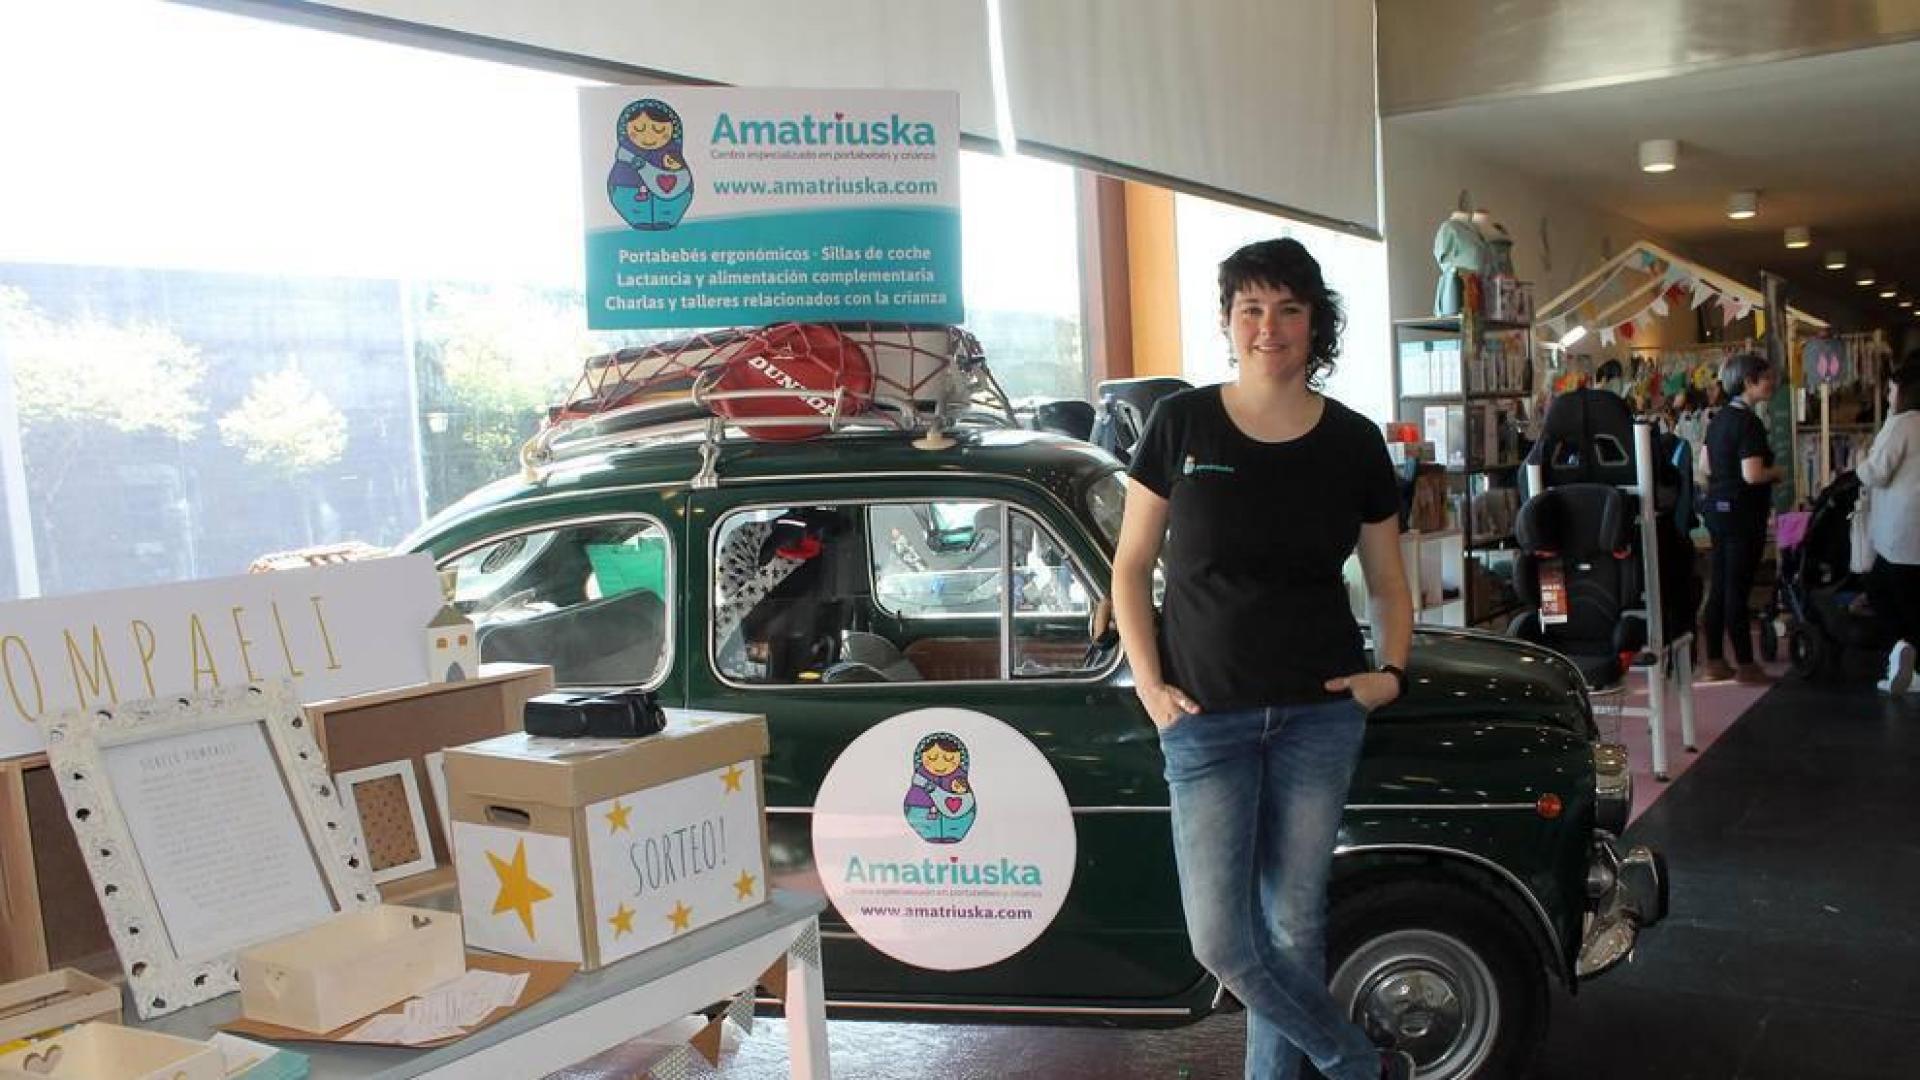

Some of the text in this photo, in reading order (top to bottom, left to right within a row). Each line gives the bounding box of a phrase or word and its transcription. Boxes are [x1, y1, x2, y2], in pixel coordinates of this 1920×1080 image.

[710, 111, 936, 145] Amatriuska
[713, 176, 937, 195] www.amatriuska.com
[619, 245, 932, 266] Portabebés ergonómicos Sillas de coche
[617, 267, 934, 289] Lactancia y alimentación complementaria
[605, 290, 948, 312] Charlas y talleres relacionados con la crianza
[629, 815, 726, 897] SORTEO!
[844, 856, 1042, 886] Amatriuska
[861, 904, 1033, 920] www.amatriuska.com
